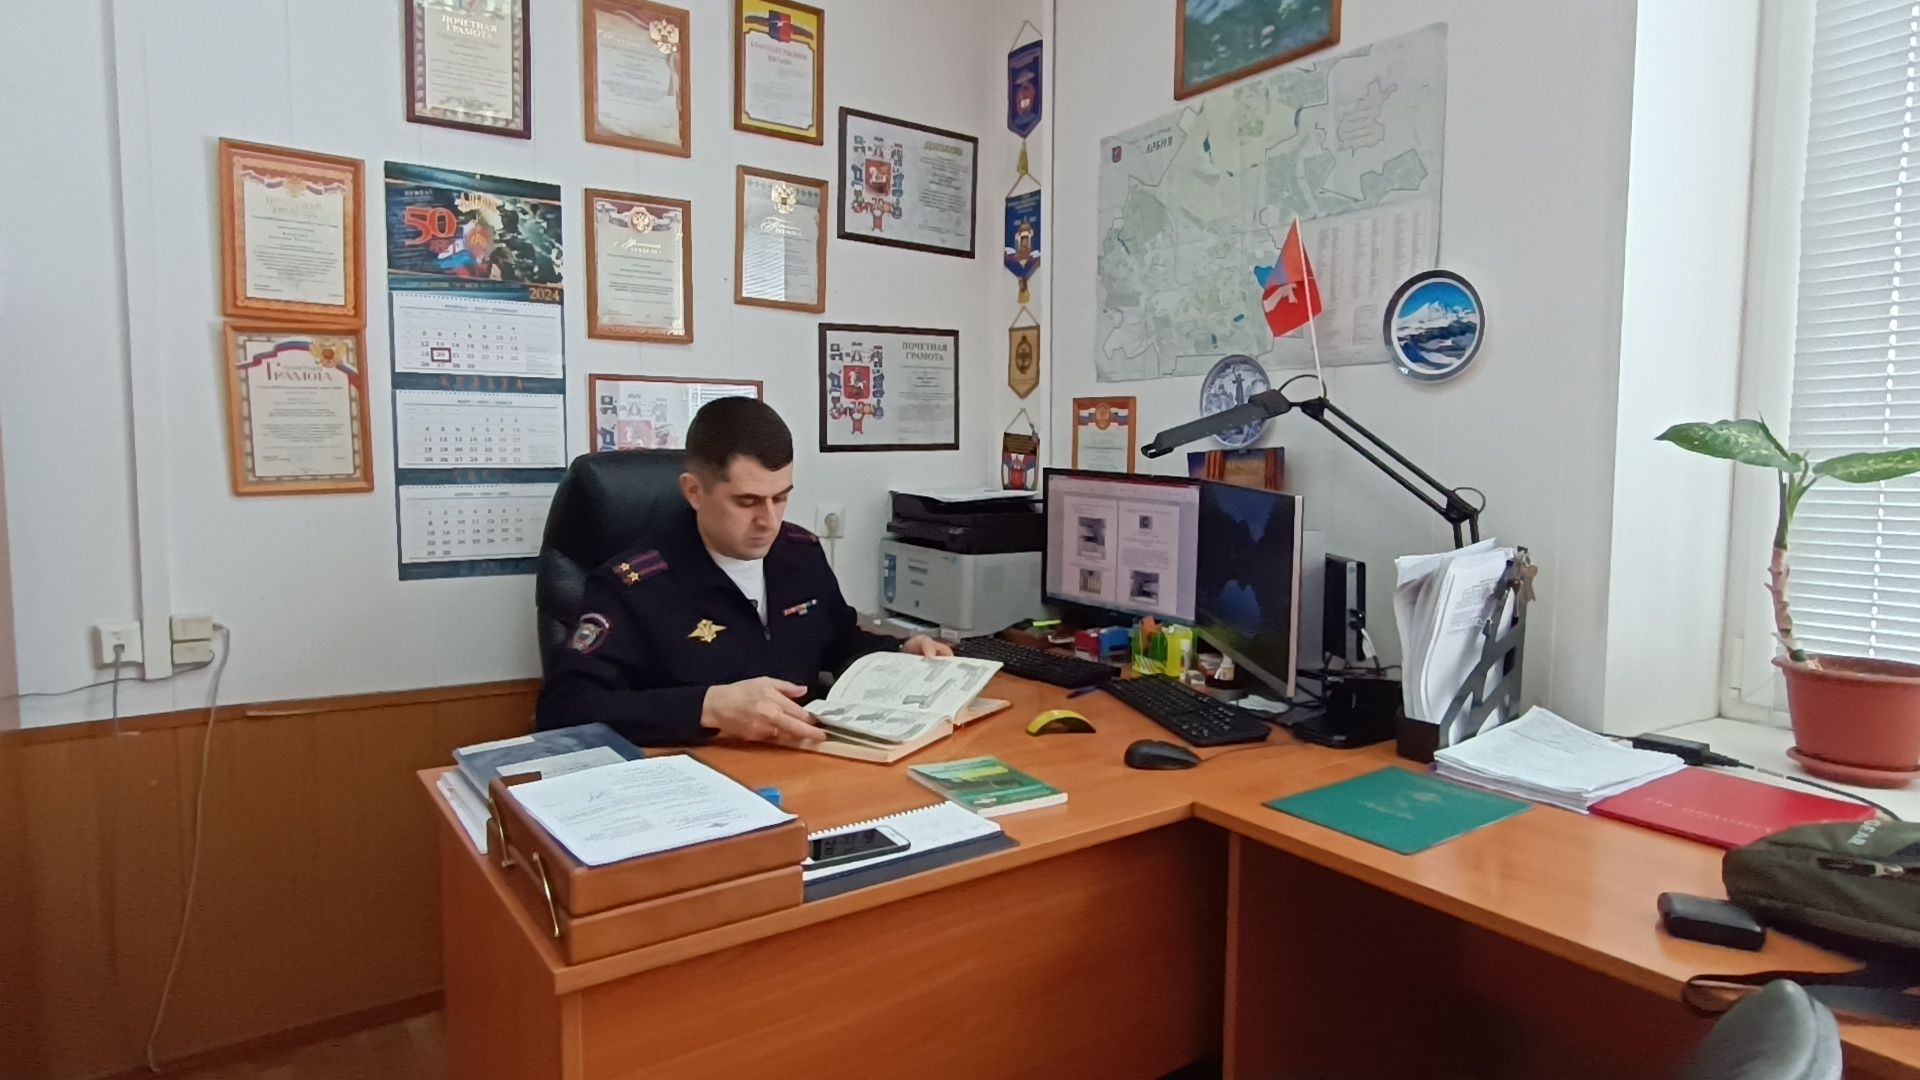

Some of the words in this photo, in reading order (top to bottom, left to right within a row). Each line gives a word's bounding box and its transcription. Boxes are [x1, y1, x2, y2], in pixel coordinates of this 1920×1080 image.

[404, 206, 457, 246] 50
[529, 287, 560, 301] 2024
[905, 351, 945, 361] ГРАМОТА
